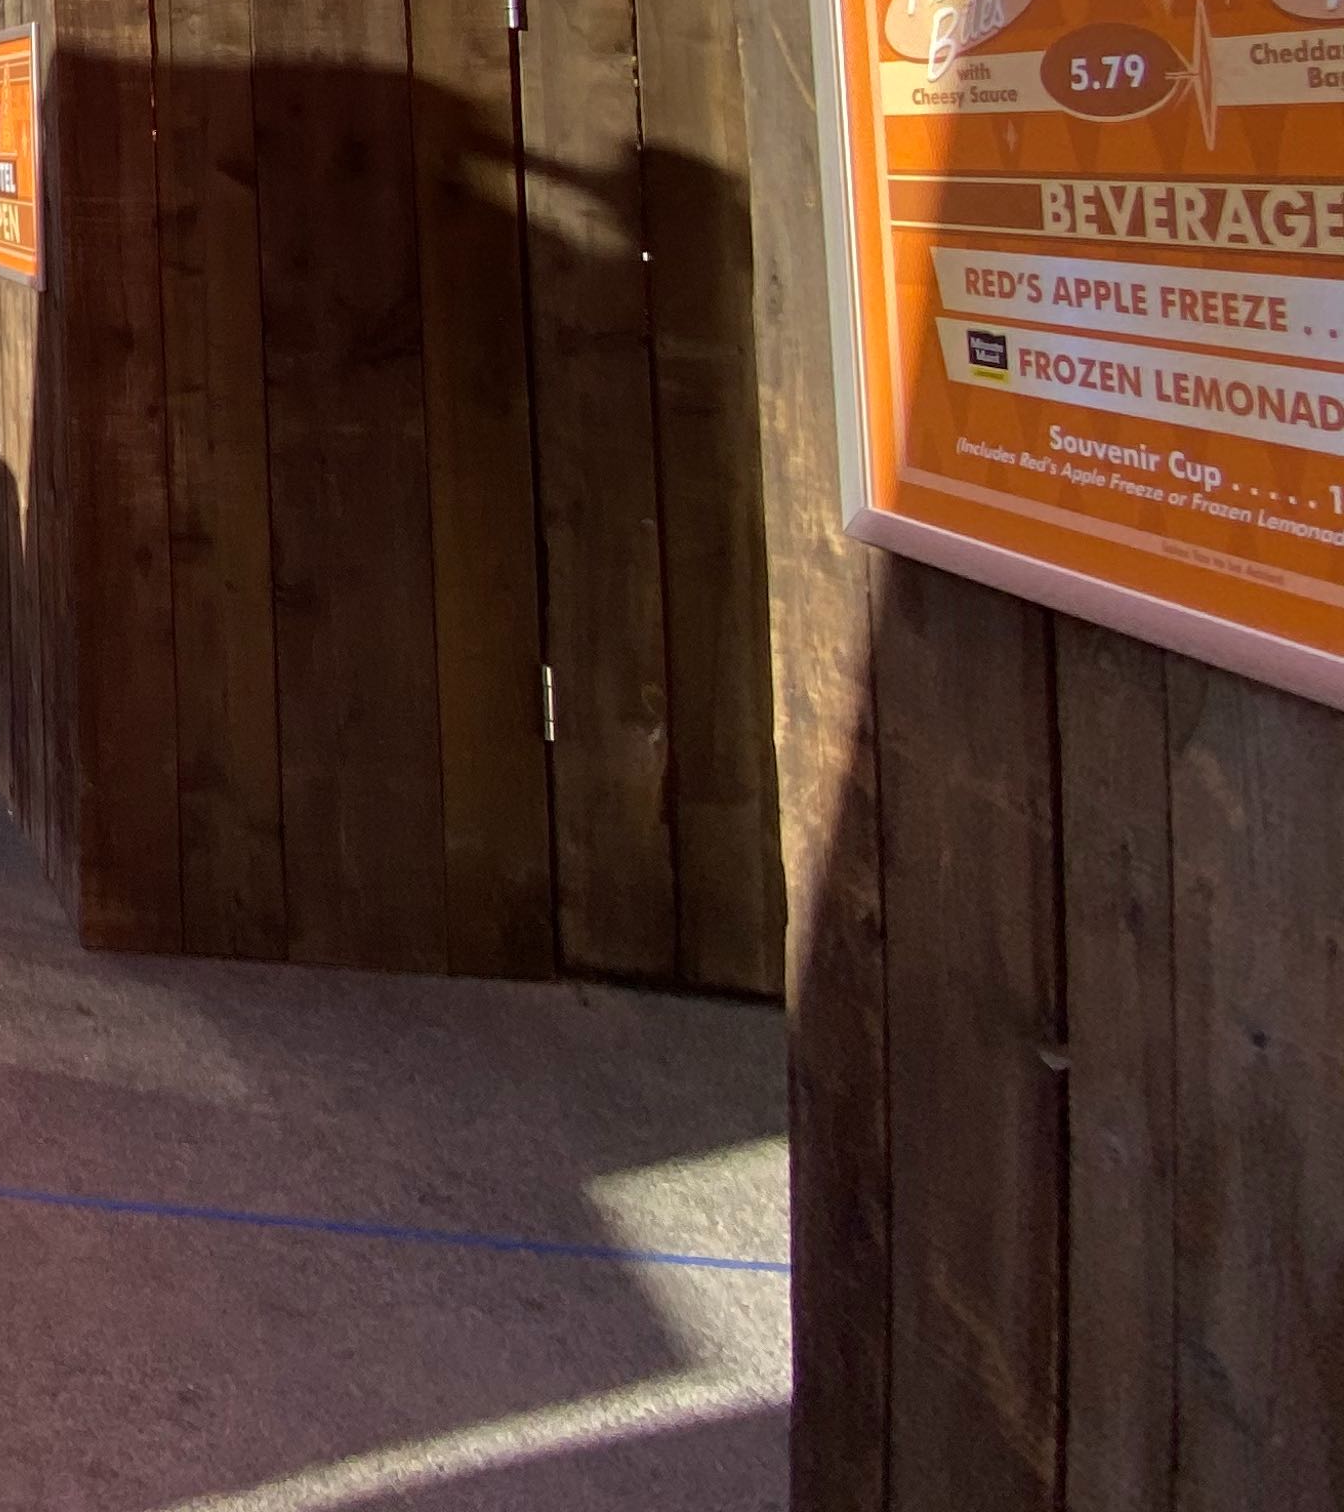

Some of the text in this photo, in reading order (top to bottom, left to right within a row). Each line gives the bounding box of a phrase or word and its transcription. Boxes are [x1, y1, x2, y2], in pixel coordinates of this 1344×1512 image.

[957, 63, 992, 81] with
[1070, 54, 1146, 91] 5.79
[1250, 39, 1344, 65] Chedda
[912, 85, 1018, 107] Cheesy Sauce
[965, 266, 1288, 333] RED'S APPLE FREEZE
[1018, 347, 1144, 398] FROZEN
[1155, 370, 1344, 432] LEMONAD
[956, 436, 1016, 465] (Includes
[1019, 451, 1057, 475] Red's
[1060, 463, 1106, 487] Apple
[1110, 473, 1164, 502] Freeze
[1168, 491, 1187, 507] or
[1192, 493, 1252, 523] Frozen
[1048, 425, 1161, 472] Souvenir
[1168, 450, 1221, 492] Cup
